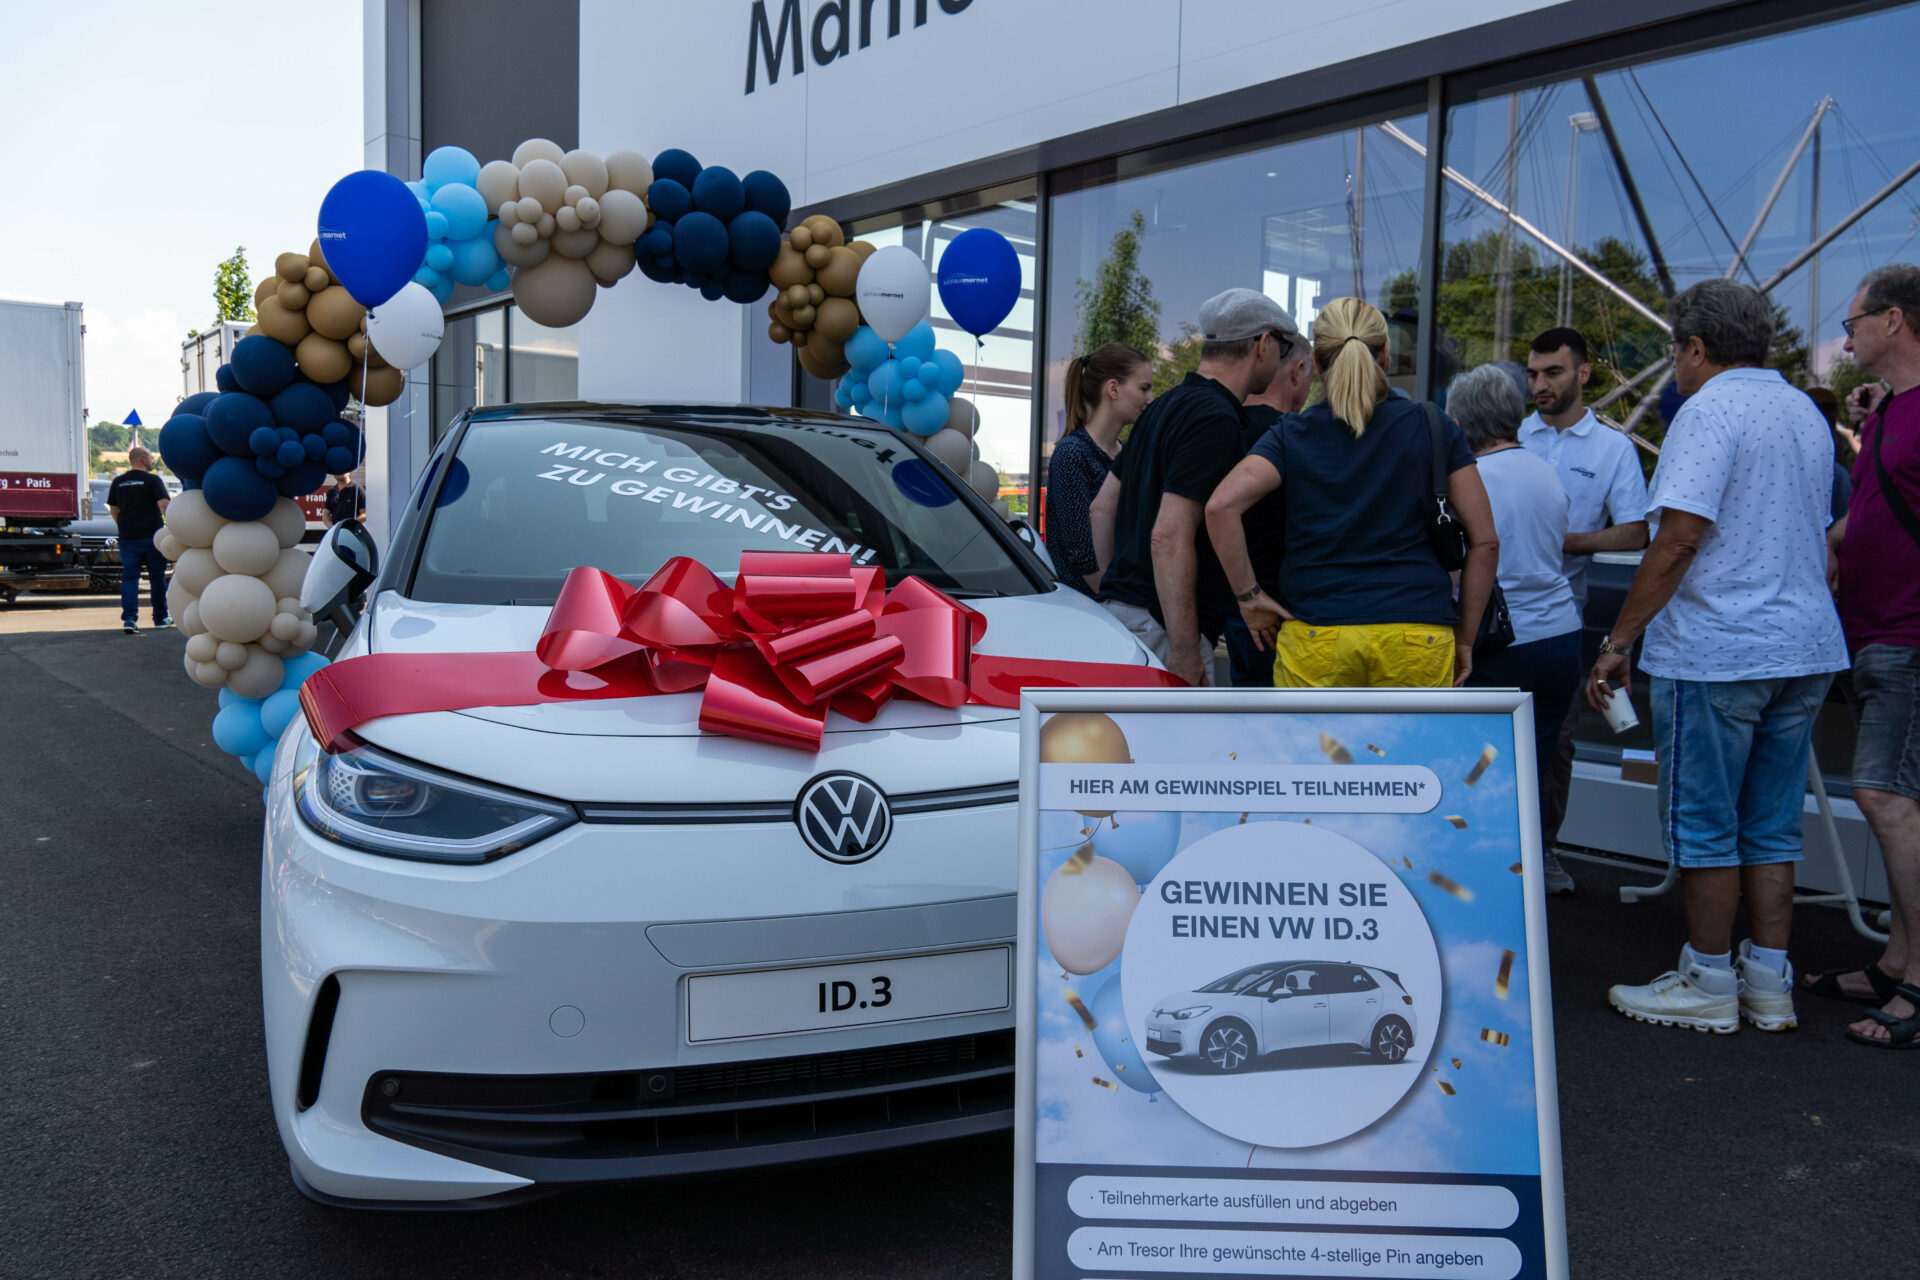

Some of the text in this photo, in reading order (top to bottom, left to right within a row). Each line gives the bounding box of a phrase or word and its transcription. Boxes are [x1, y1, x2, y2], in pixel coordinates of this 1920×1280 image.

[744, 0, 975, 96] Marn
[26, 477, 51, 488] Paris
[540, 442, 797, 510] MICH GIBT'S
[536, 464, 877, 564] ZU GEWINNEN!
[1070, 779, 1114, 795] HIER
[1119, 779, 1150, 795] AM
[1154, 780, 1287, 797] GEWINNSPIEL
[1160, 880, 1388, 907] GEWINNEN SIE
[1172, 915, 1380, 941] EINEN VW ID.3
[818, 976, 892, 1013] ID.3
[1099, 1190, 1397, 1214] Teilnehmerkarte ausfüllen und abgeben
[1097, 1241, 1484, 1268] Am Tresor Ihre gewünschte 4-stellige Pin angeben
